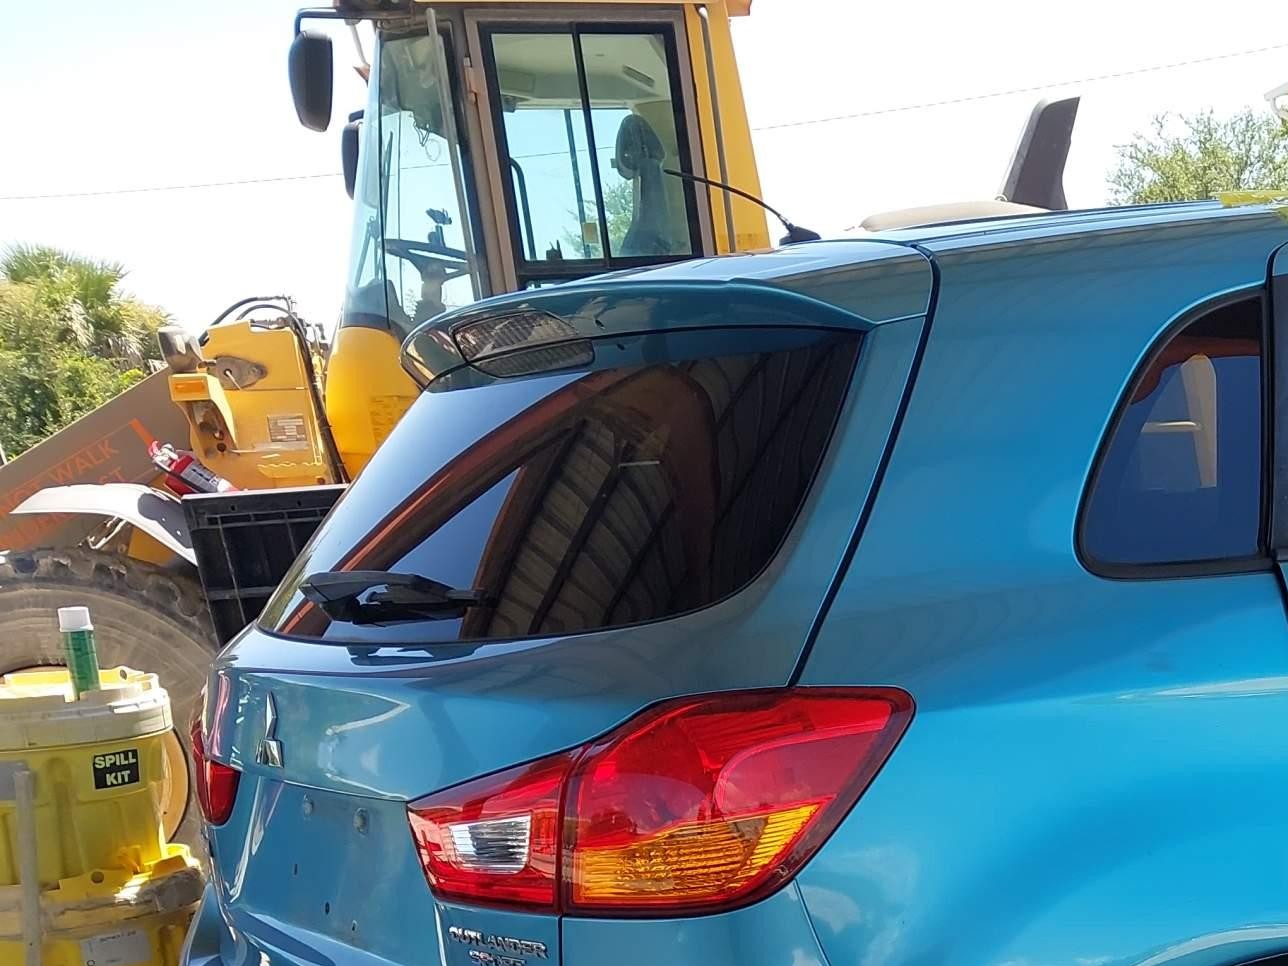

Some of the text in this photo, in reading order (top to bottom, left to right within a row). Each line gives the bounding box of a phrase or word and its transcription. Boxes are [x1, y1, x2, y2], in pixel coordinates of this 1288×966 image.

[49, 440, 119, 484] WALK
[94, 751, 137, 768] SPILL
[105, 770, 131, 786] KIT
[448, 926, 549, 960] OUTLANDER
